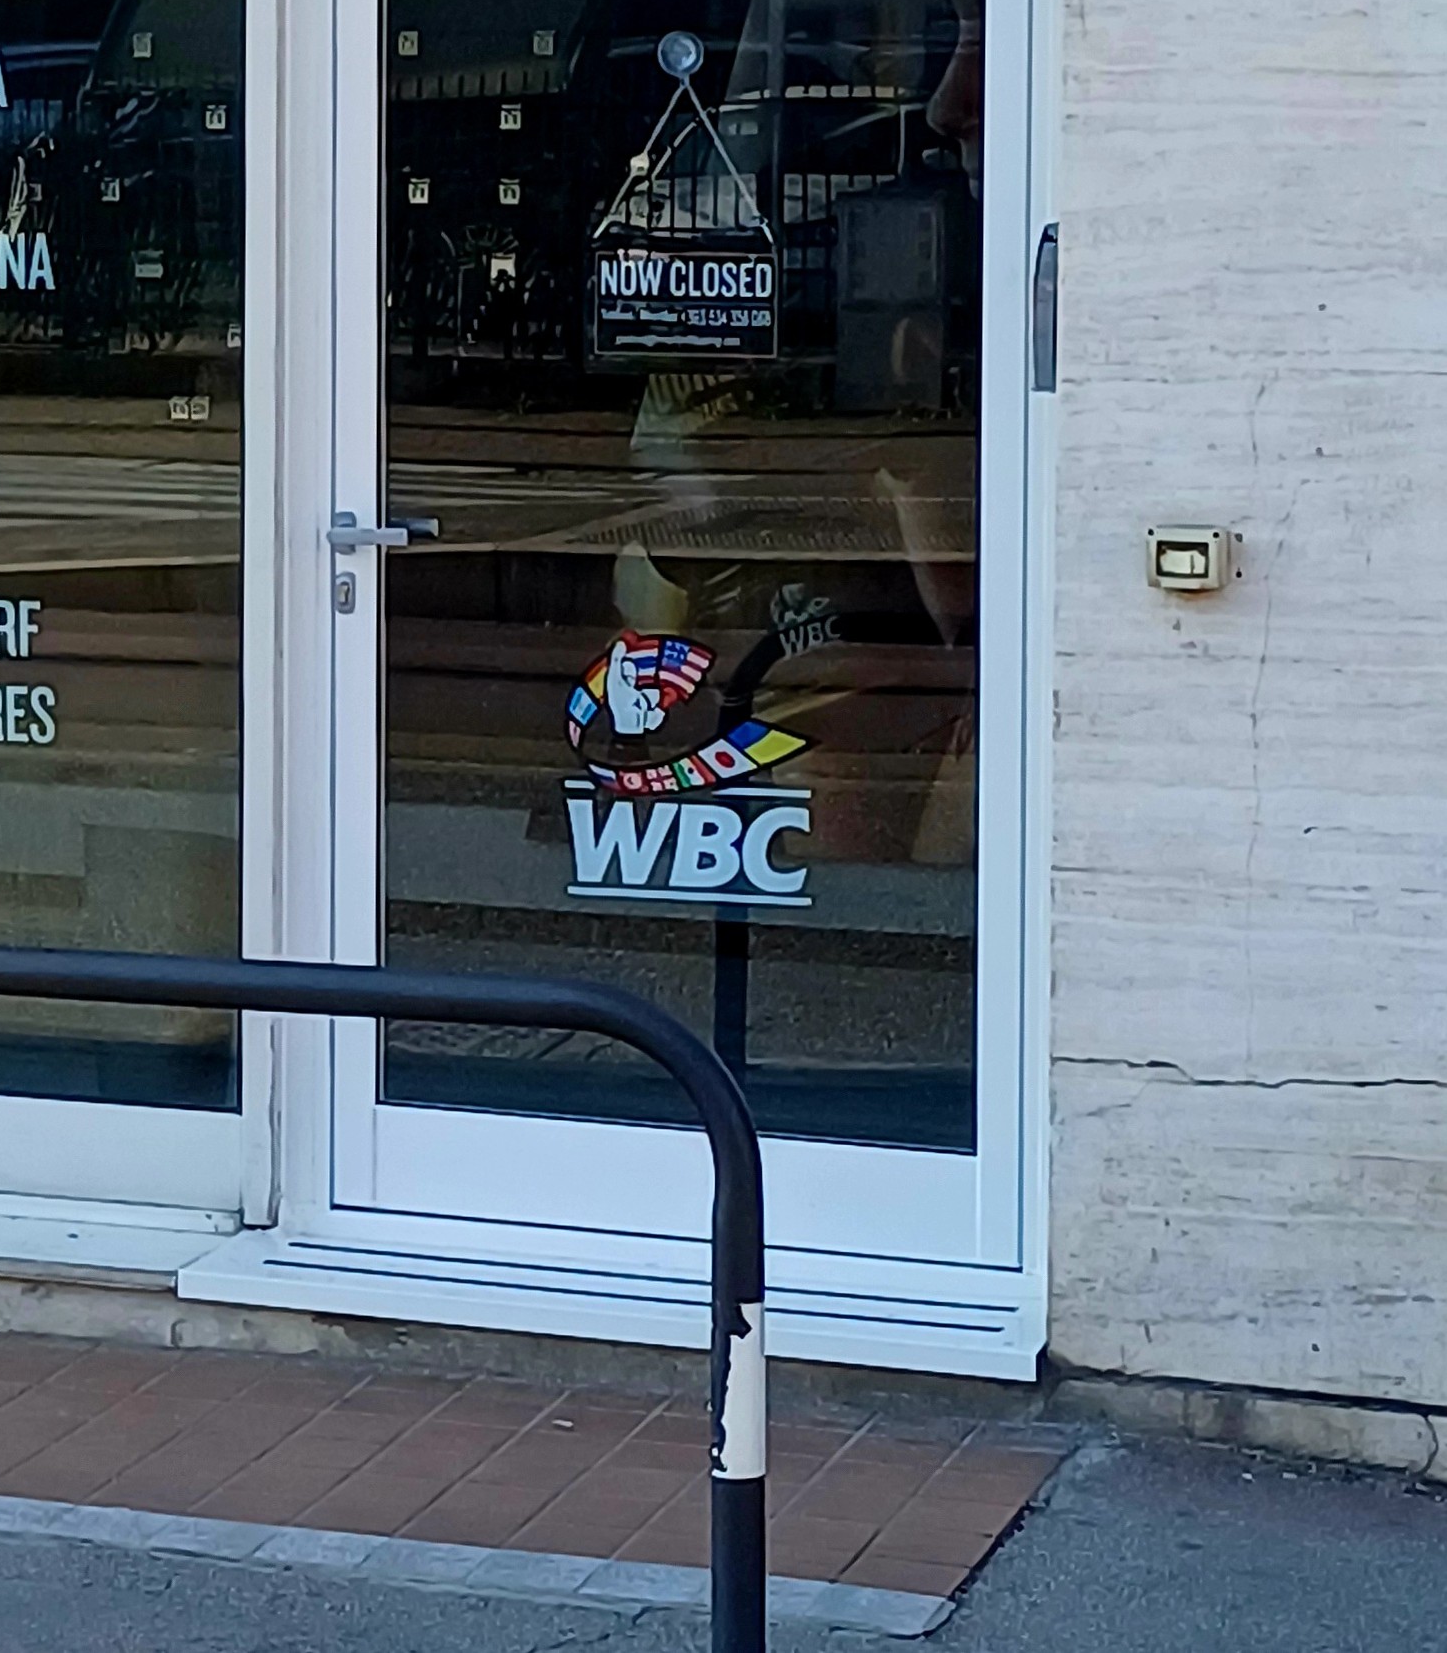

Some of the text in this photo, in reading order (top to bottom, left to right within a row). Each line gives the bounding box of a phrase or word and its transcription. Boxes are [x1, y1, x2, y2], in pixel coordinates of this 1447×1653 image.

[600, 260, 773, 298] NOW CLOSED
[566, 798, 811, 893] WBC
